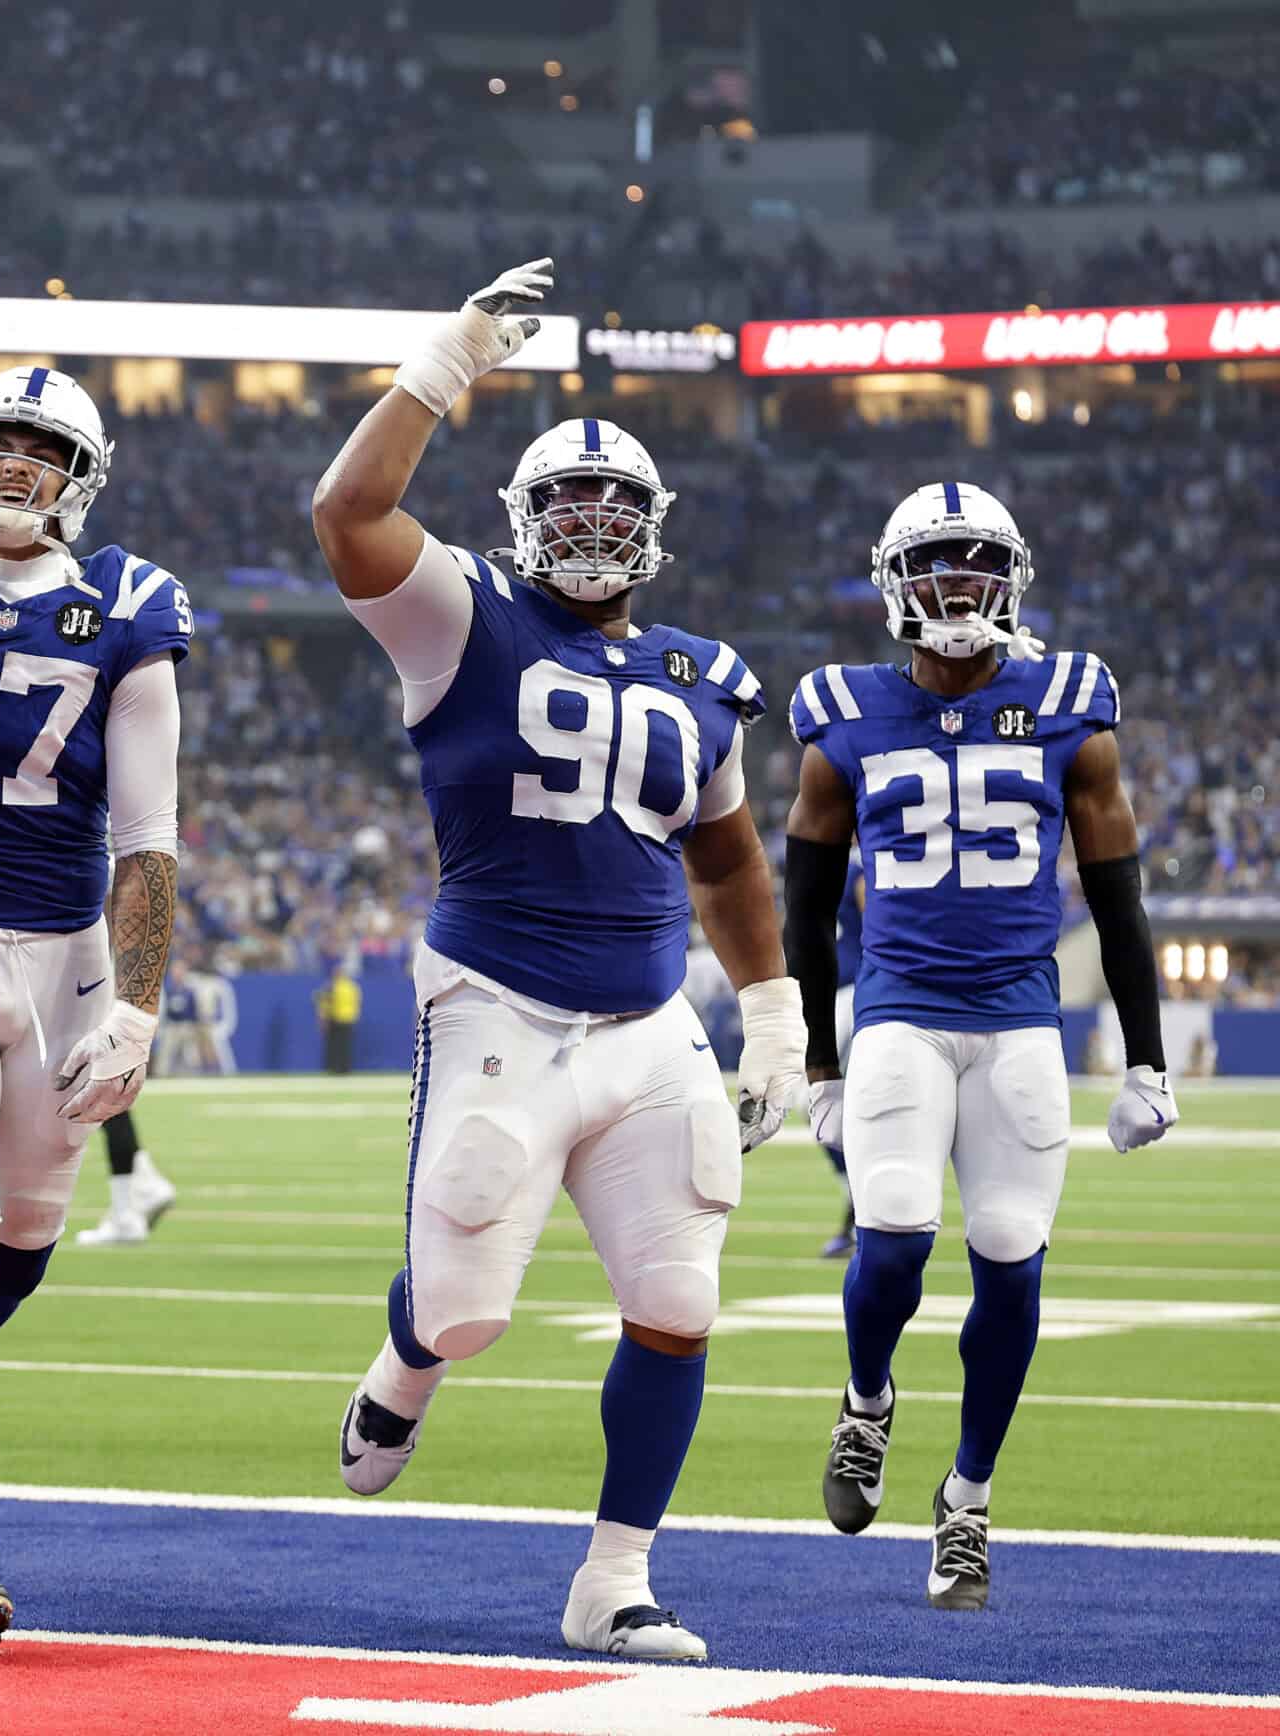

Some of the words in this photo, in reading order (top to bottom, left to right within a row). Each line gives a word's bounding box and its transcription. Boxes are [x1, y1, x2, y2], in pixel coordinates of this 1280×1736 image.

[579, 453, 609, 462] COLTS
[512, 659, 701, 844] 90
[861, 744, 1044, 890] 35
